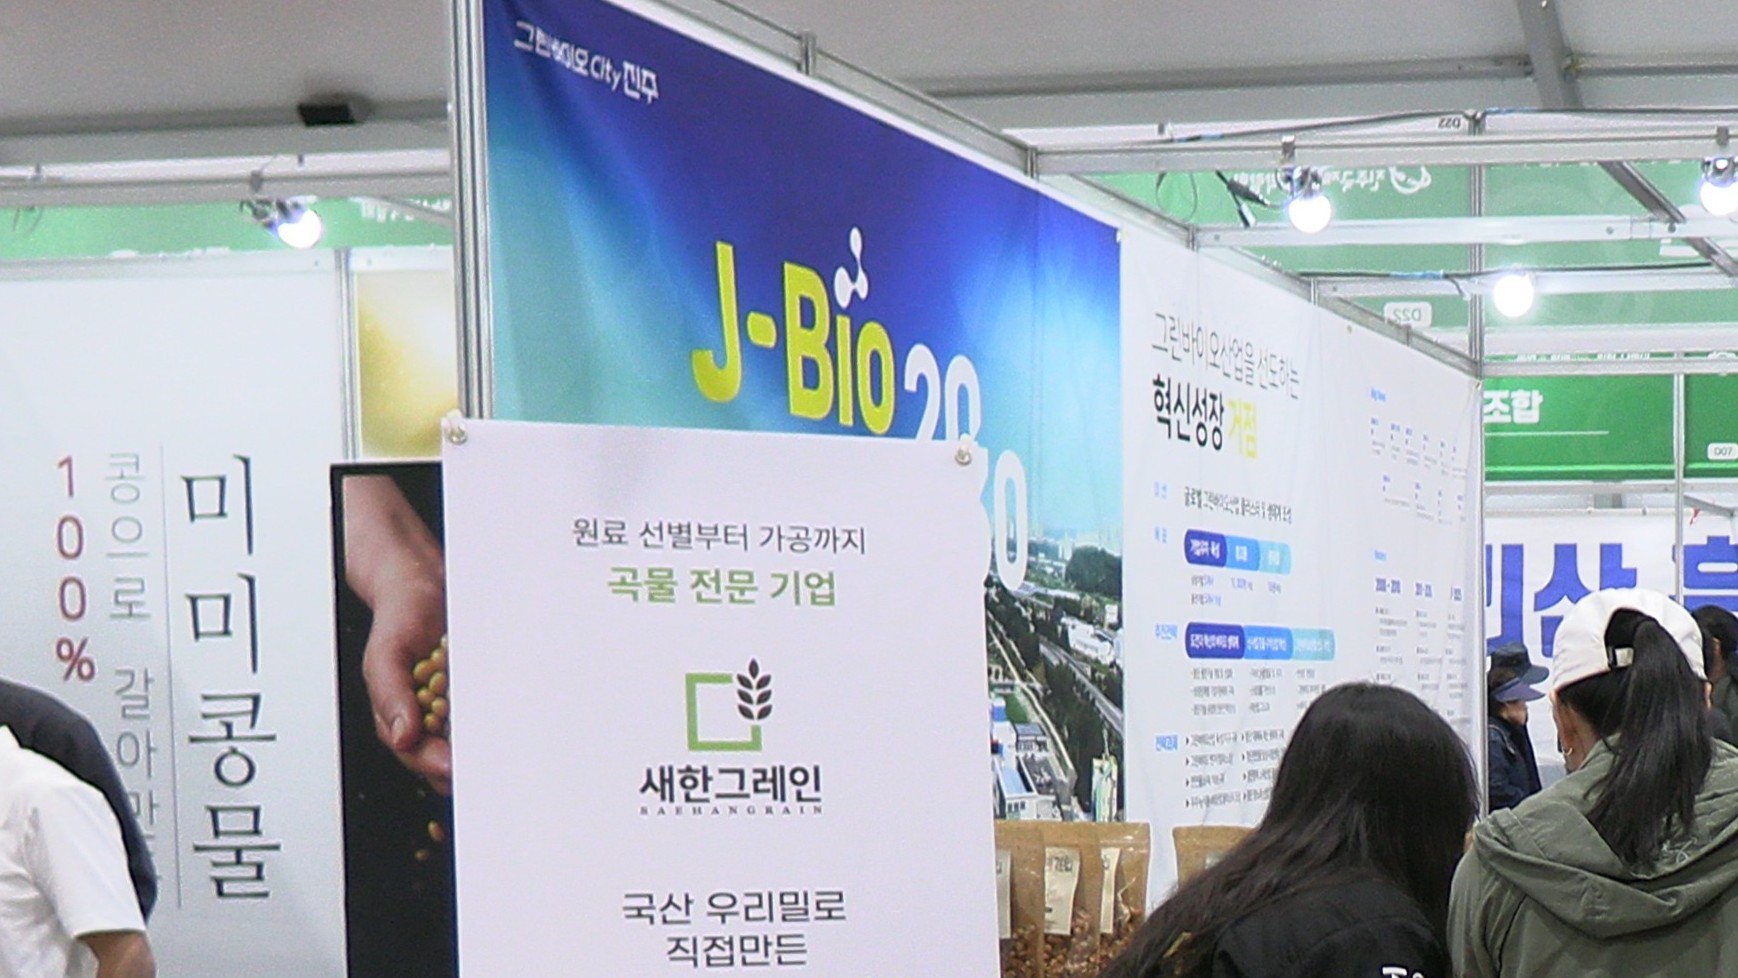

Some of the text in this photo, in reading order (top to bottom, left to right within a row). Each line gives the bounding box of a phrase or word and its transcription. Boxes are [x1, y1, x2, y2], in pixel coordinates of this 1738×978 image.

[692, 241, 896, 434] J-Bio
[1152, 312, 1255, 388] 그린바이오산업을
[1152, 373, 1224, 451] 혁신성장
[571, 517, 866, 555] 원료 선별부터 가공까지
[607, 566, 837, 608] 곡물 전문 기업
[180, 453, 282, 900] 미미콩물
[638, 763, 823, 804] 새한그레인
[639, 805, 824, 816] SAEHANGRAIN
[621, 890, 848, 926] 국산 우리밀로
[665, 933, 809, 969] 직접만든
